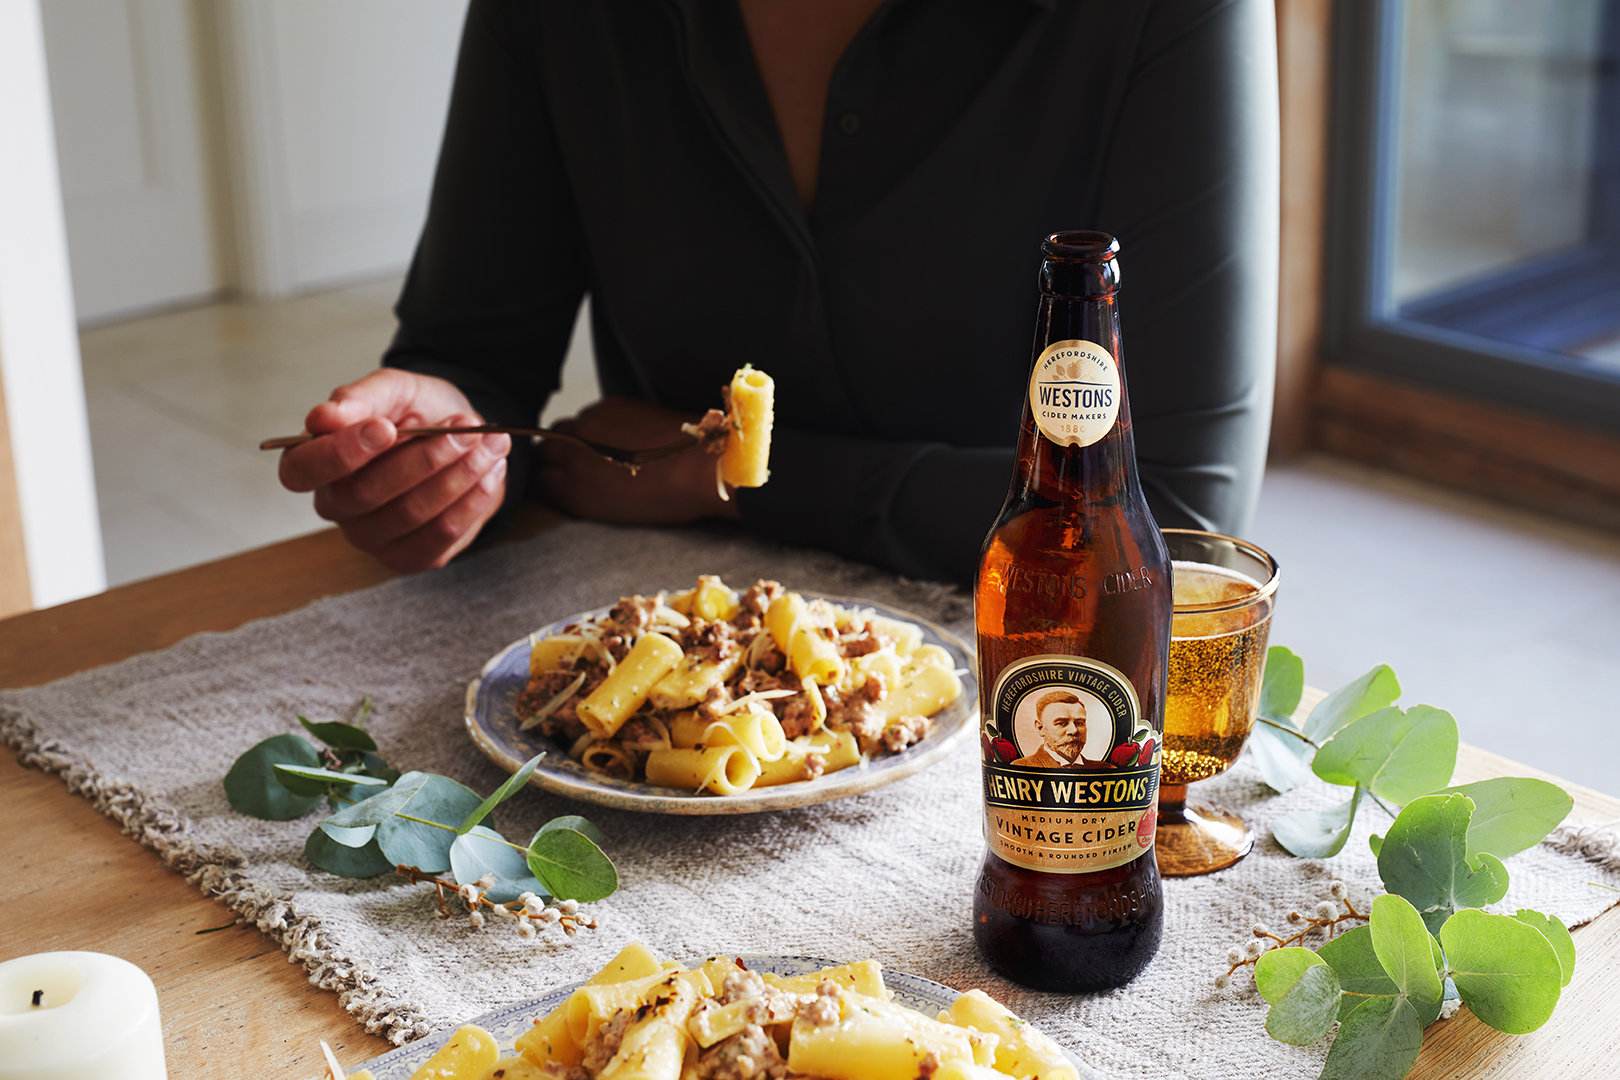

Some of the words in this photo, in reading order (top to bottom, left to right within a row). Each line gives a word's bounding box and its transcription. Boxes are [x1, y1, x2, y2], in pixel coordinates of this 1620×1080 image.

[1043, 351, 1108, 371] HEREFORDSHIRE
[1039, 386, 1112, 408] WESTONS
[1042, 411, 1067, 419] CIDER
[1060, 424, 1087, 433] 1880
[1000, 562, 1087, 599] WESTONS
[1103, 566, 1152, 595] CIDER
[1002, 670, 1063, 713] HEREFORDSHIRE
[1068, 671, 1110, 694] VINTAGE
[1108, 690, 1127, 718] CIDER
[987, 774, 1044, 803] HENRY
[1051, 777, 1148, 804] WESTONS
[996, 815, 1074, 844] VINTAGE
[1082, 821, 1136, 843] CIDER
[1021, 815, 1073, 824] MEDIUM
[1000, 840, 1033, 856] SMOOTH
[1103, 843, 1132, 856] FINISH
